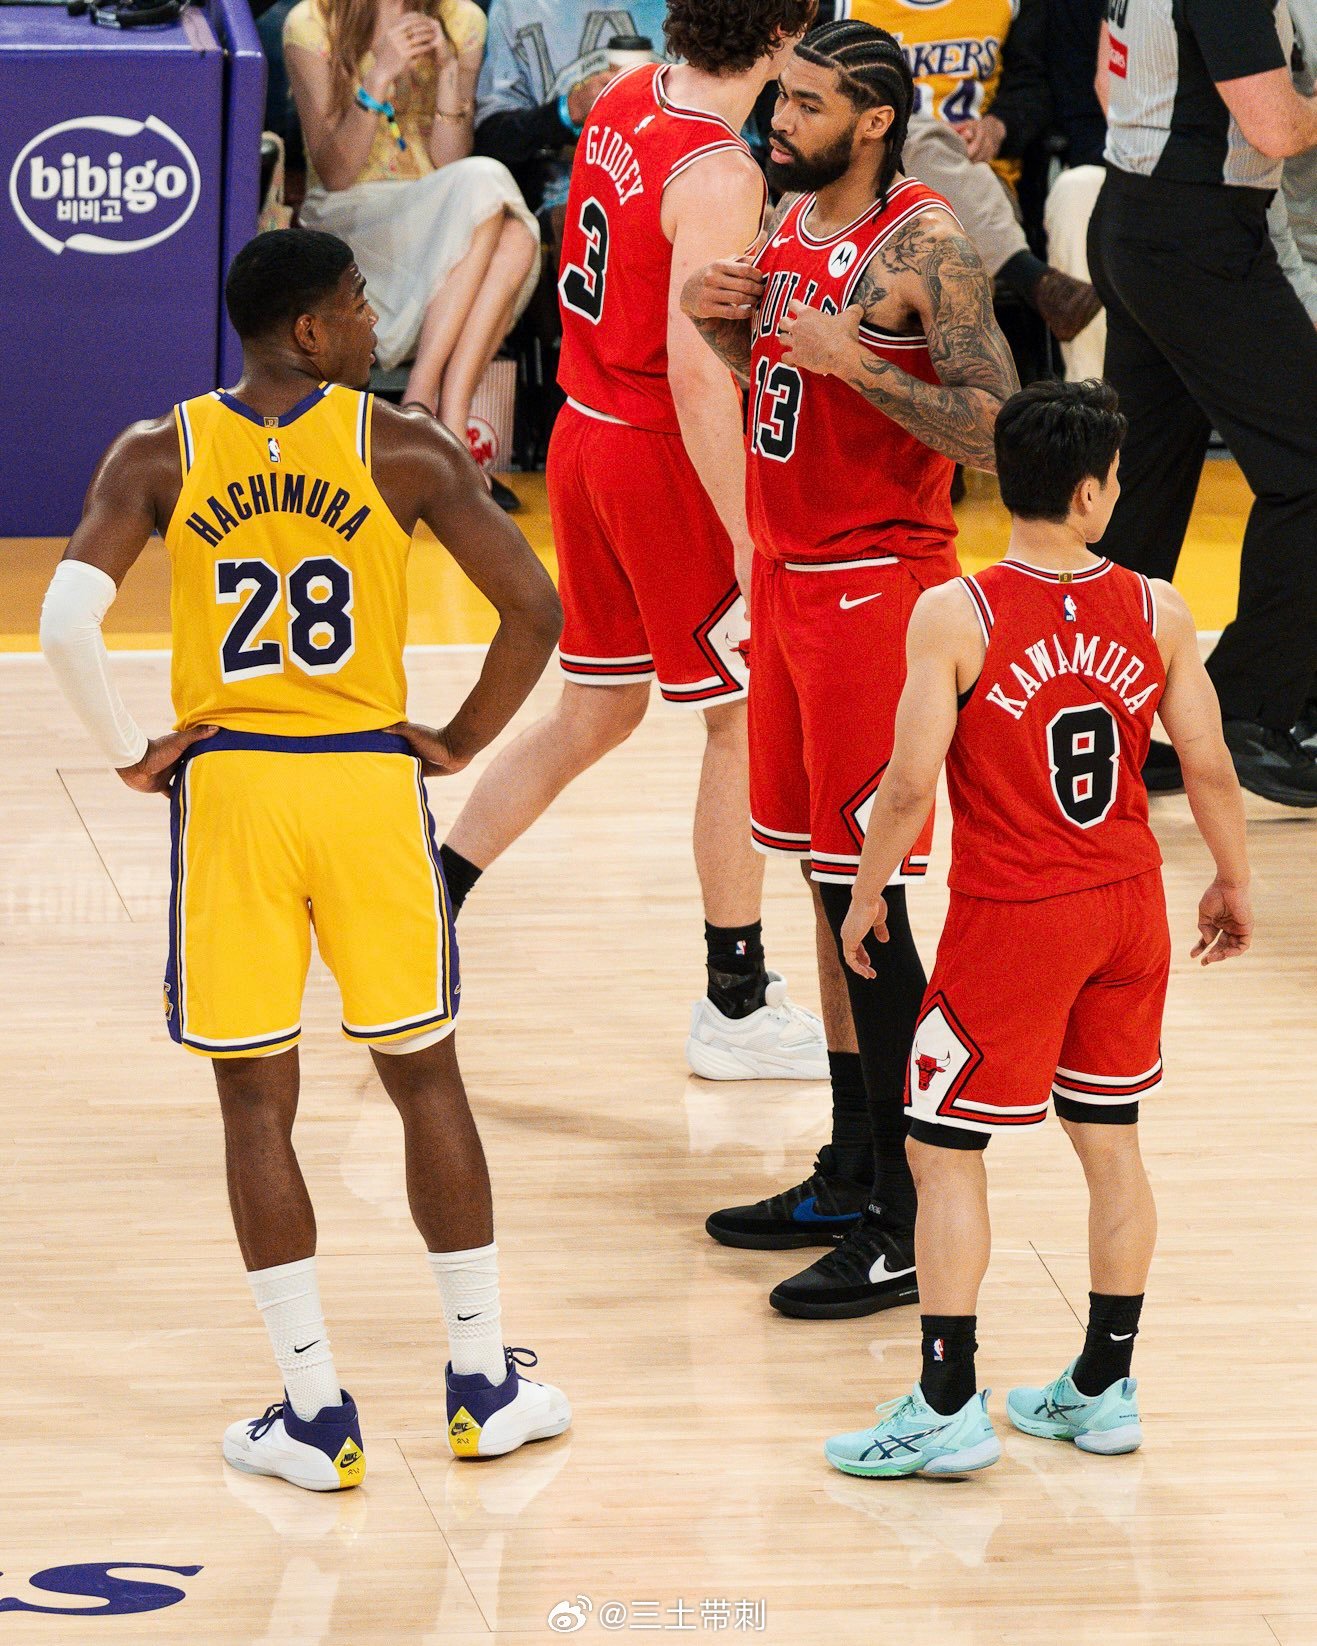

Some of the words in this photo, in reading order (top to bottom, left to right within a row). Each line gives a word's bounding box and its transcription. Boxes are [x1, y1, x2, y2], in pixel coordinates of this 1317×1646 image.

[30, 152, 188, 213] bibigo
[586, 125, 644, 206] GIDDEY
[56, 199, 124, 225] 비비고
[557, 196, 610, 326] 3
[751, 356, 804, 463] 13
[185, 472, 372, 548] HACHIMURA
[214, 554, 356, 685] 28
[985, 632, 1159, 720] KAWAMURA
[1045, 701, 1121, 830] 8
